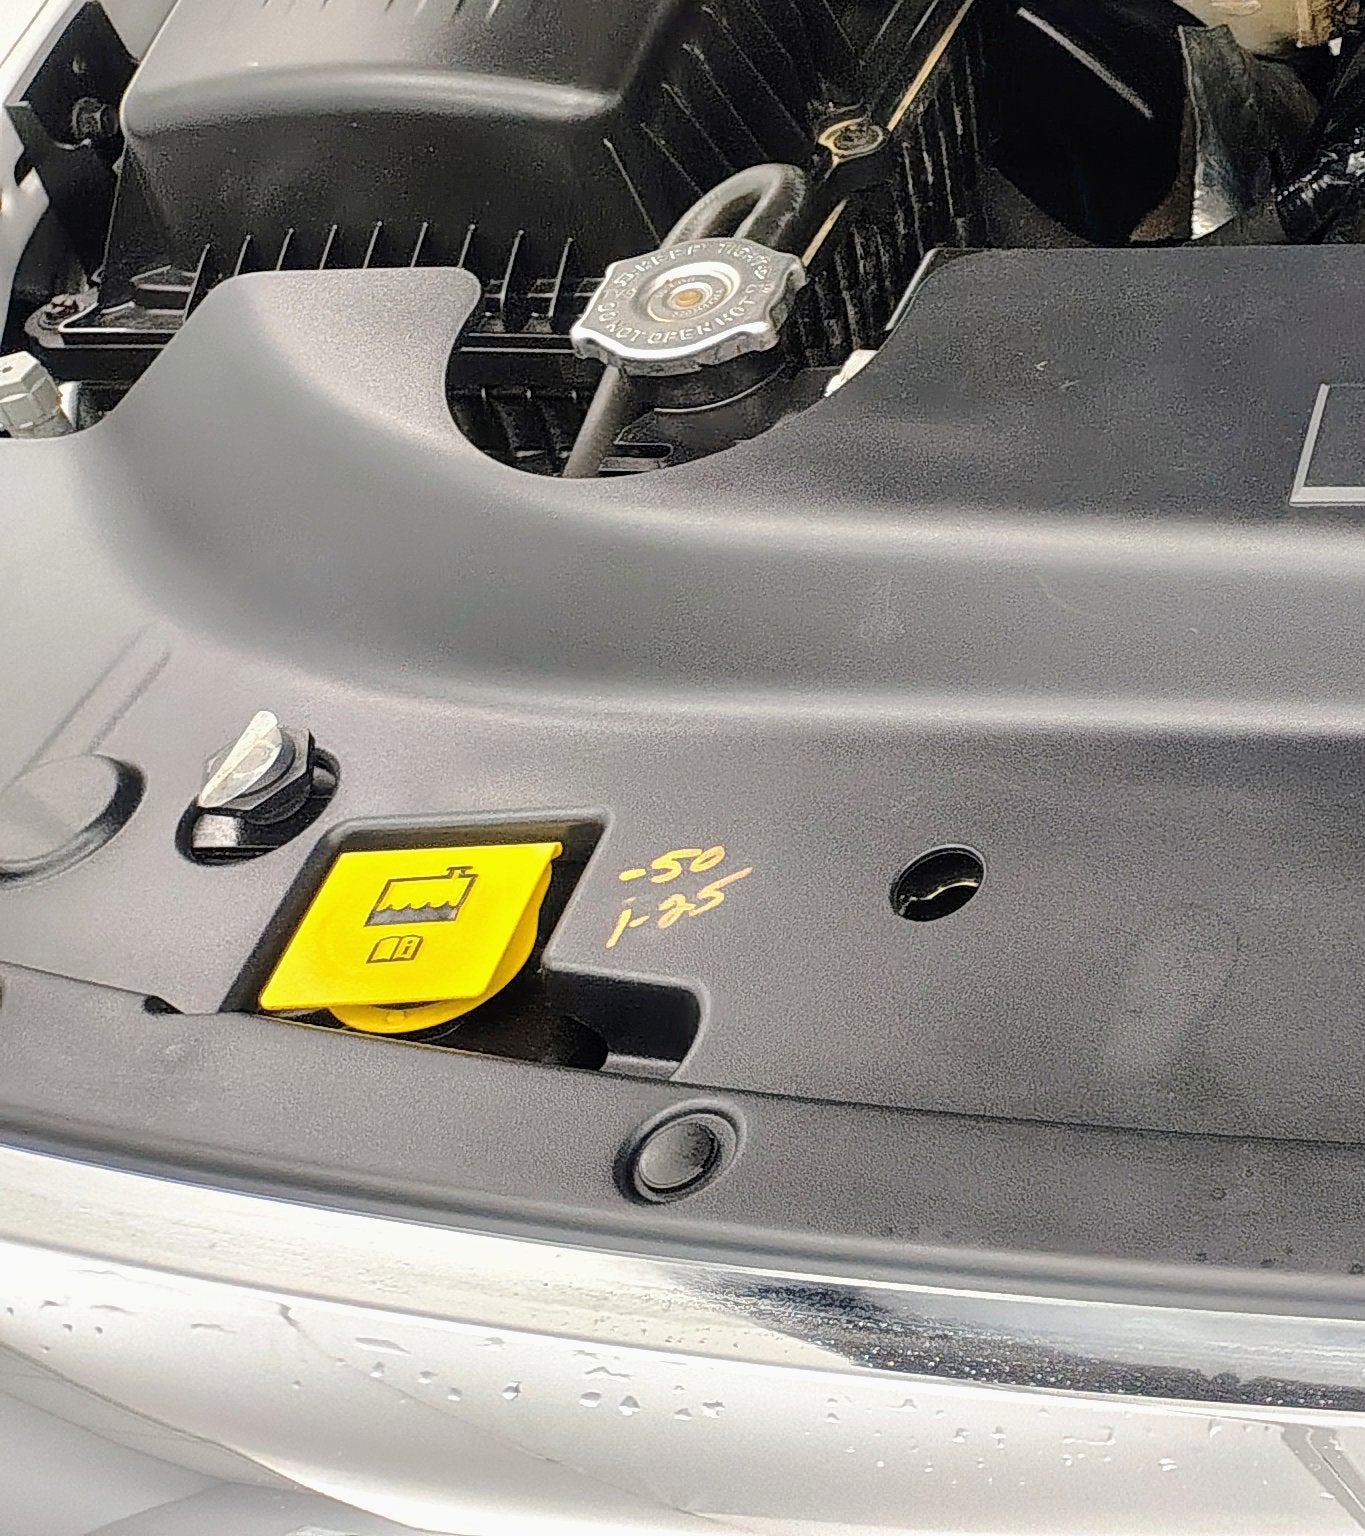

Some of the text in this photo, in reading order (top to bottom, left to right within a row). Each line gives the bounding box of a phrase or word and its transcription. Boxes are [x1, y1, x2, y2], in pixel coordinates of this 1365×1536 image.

[605, 318, 646, 343] NOT
[647, 321, 713, 344] OPEN
[618, 845, 726, 884] -50
